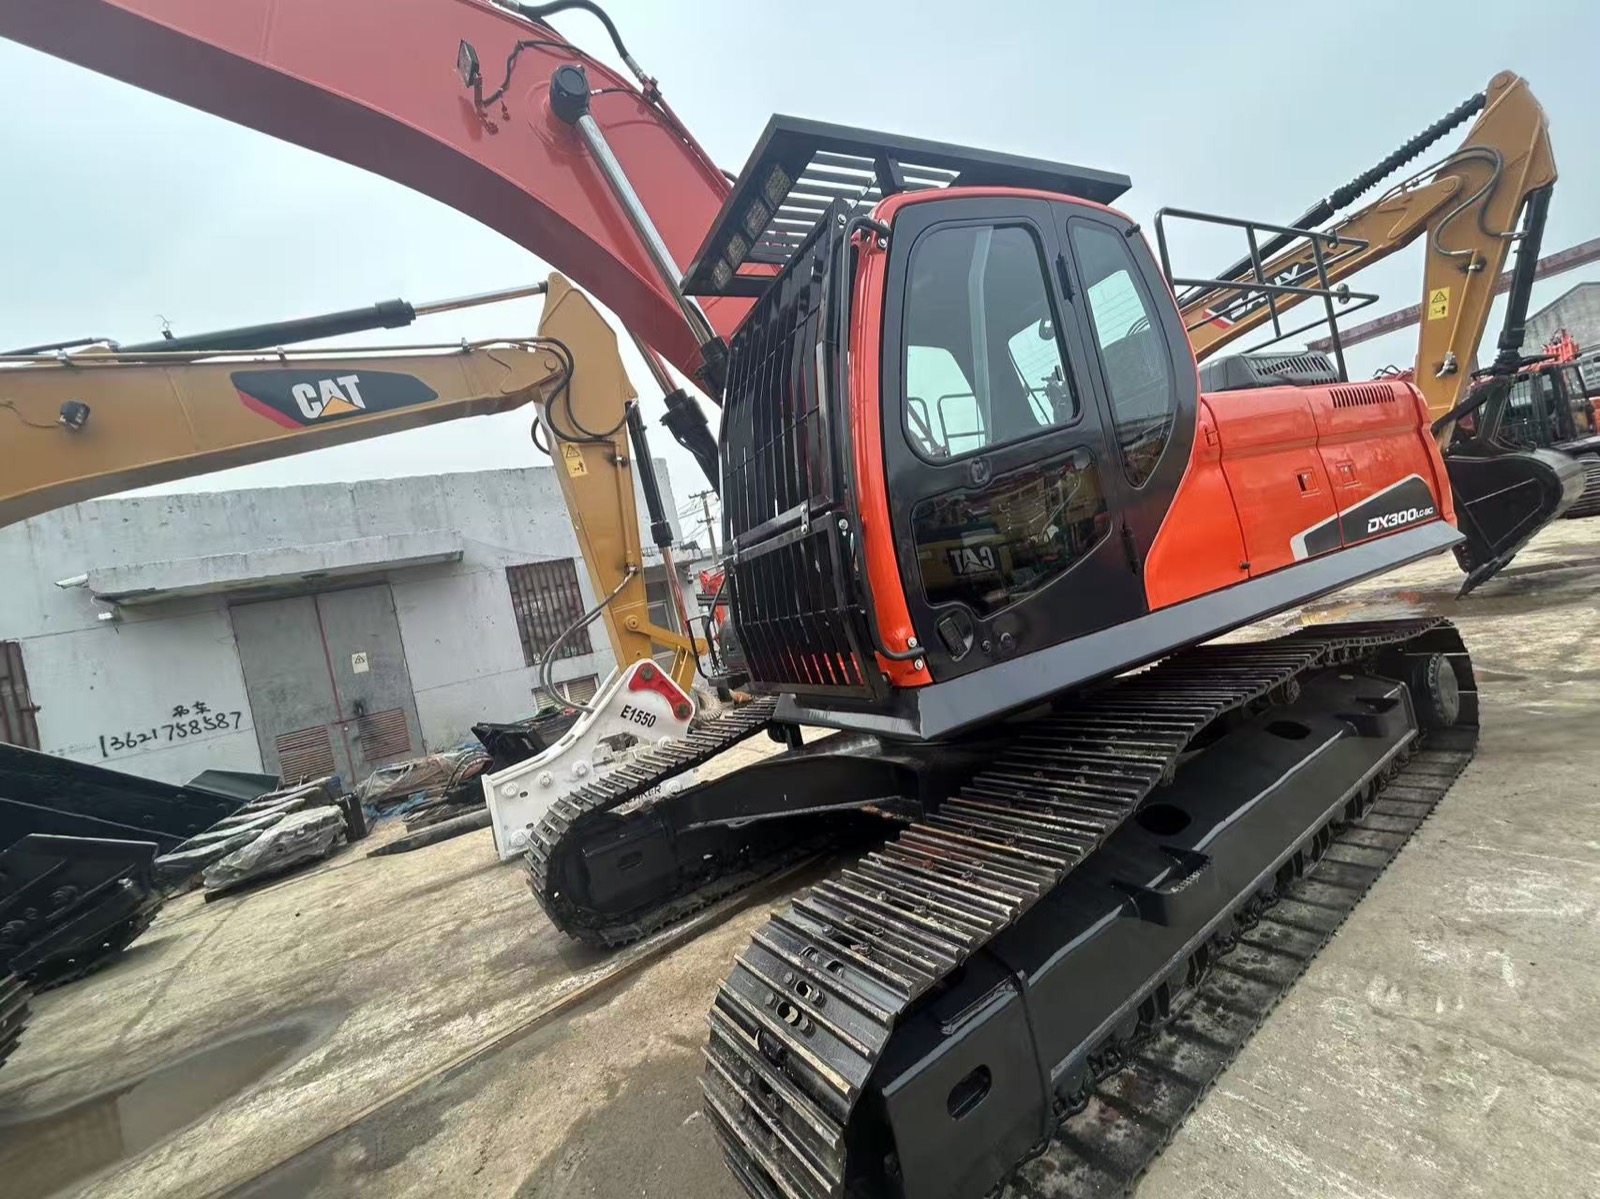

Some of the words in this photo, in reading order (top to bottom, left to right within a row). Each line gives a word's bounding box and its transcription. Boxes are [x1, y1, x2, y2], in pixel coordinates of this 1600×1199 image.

[292, 374, 366, 419] CAT
[99, 711, 242, 757] 13621758587
[620, 704, 657, 728] E1550
